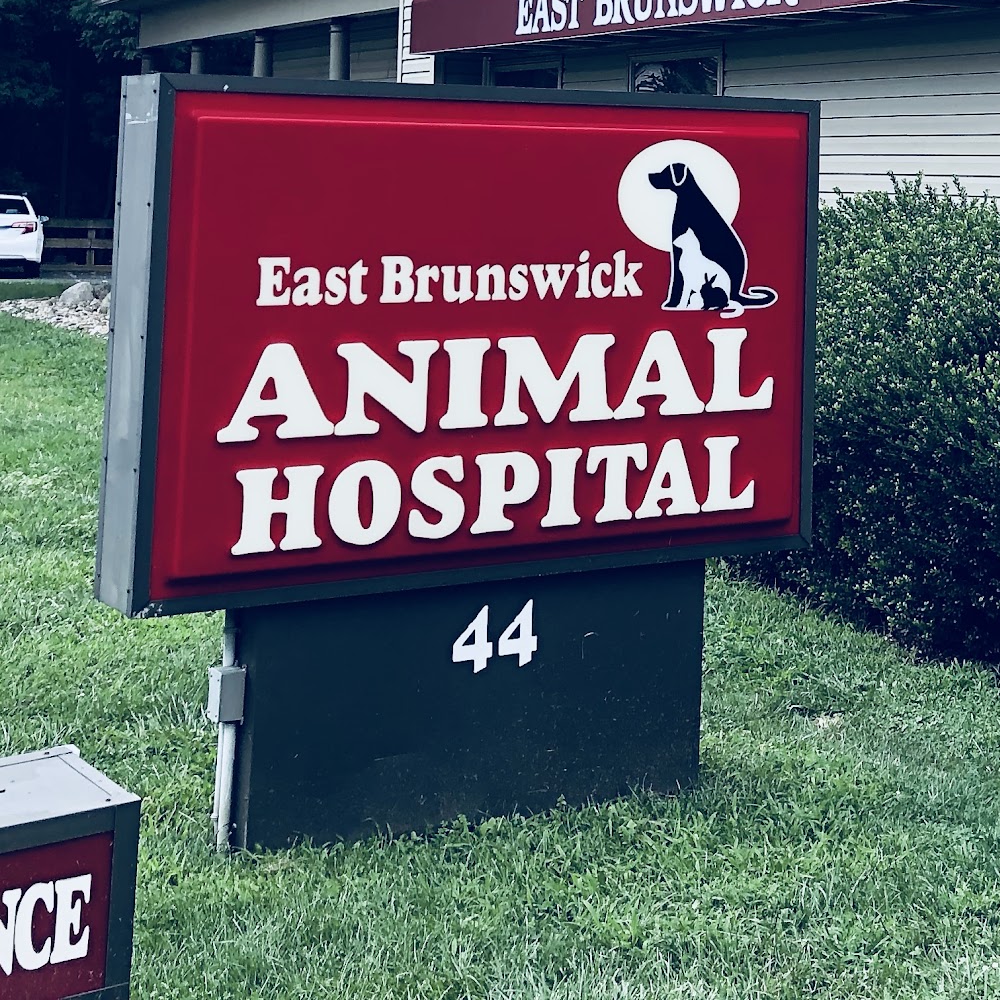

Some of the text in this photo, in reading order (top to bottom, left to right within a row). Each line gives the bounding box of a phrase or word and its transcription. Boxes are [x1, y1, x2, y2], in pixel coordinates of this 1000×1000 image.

[255, 249, 643, 307] East Brunswick
[216, 327, 774, 443] ANIMAL
[230, 435, 755, 556] HOSPITAL
[452, 598, 538, 674] 44
